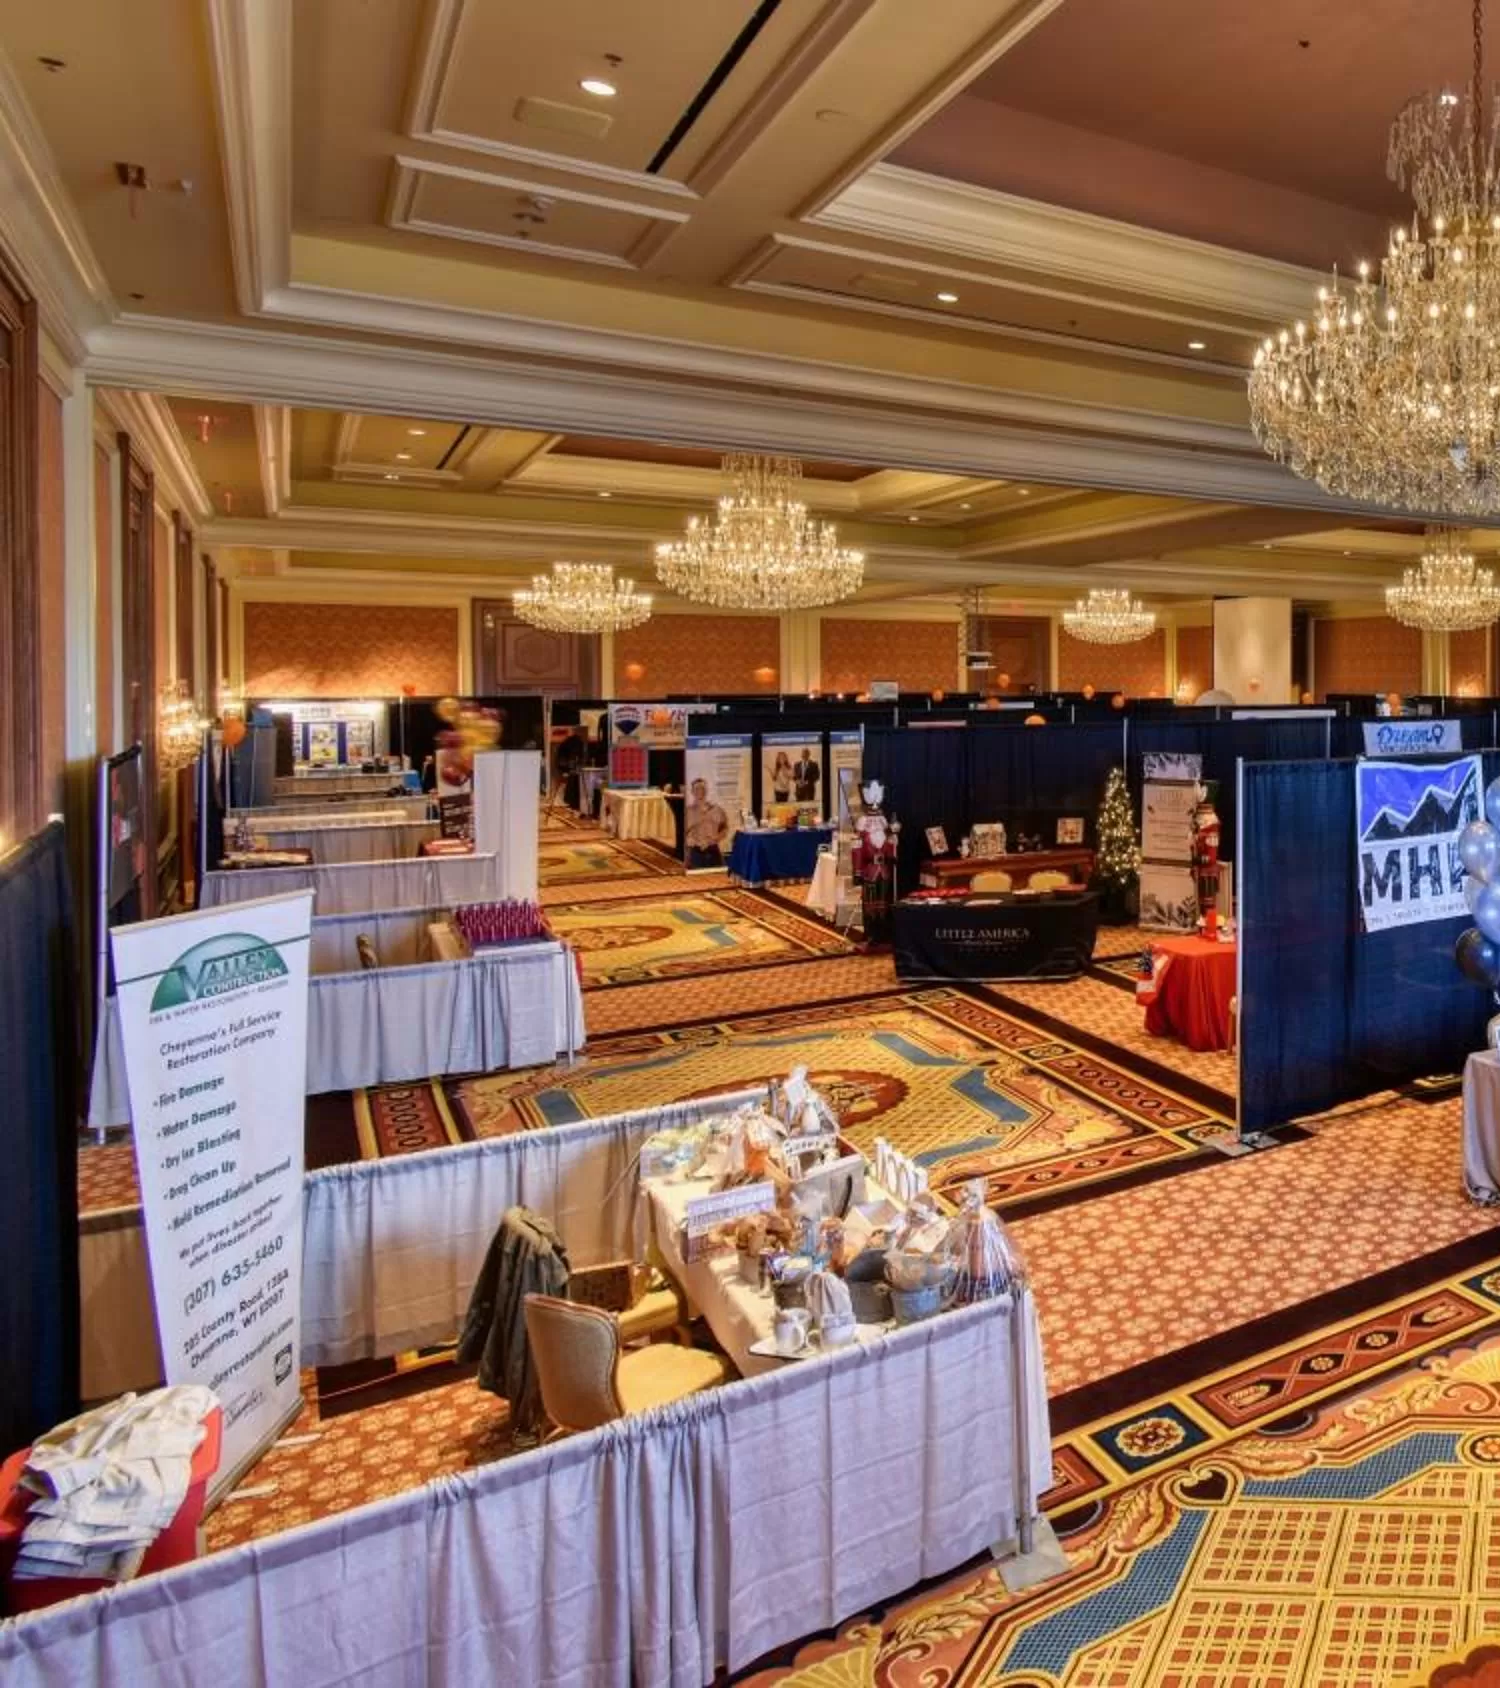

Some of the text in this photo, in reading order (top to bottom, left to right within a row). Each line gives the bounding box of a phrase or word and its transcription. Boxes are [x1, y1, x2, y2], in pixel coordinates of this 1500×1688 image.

[935, 927, 1030, 939] LITTLE AMERICA
[167, 1042, 231, 1070] Restoration
[178, 1076, 225, 1099] Damage
[191, 1100, 237, 1125] Damage
